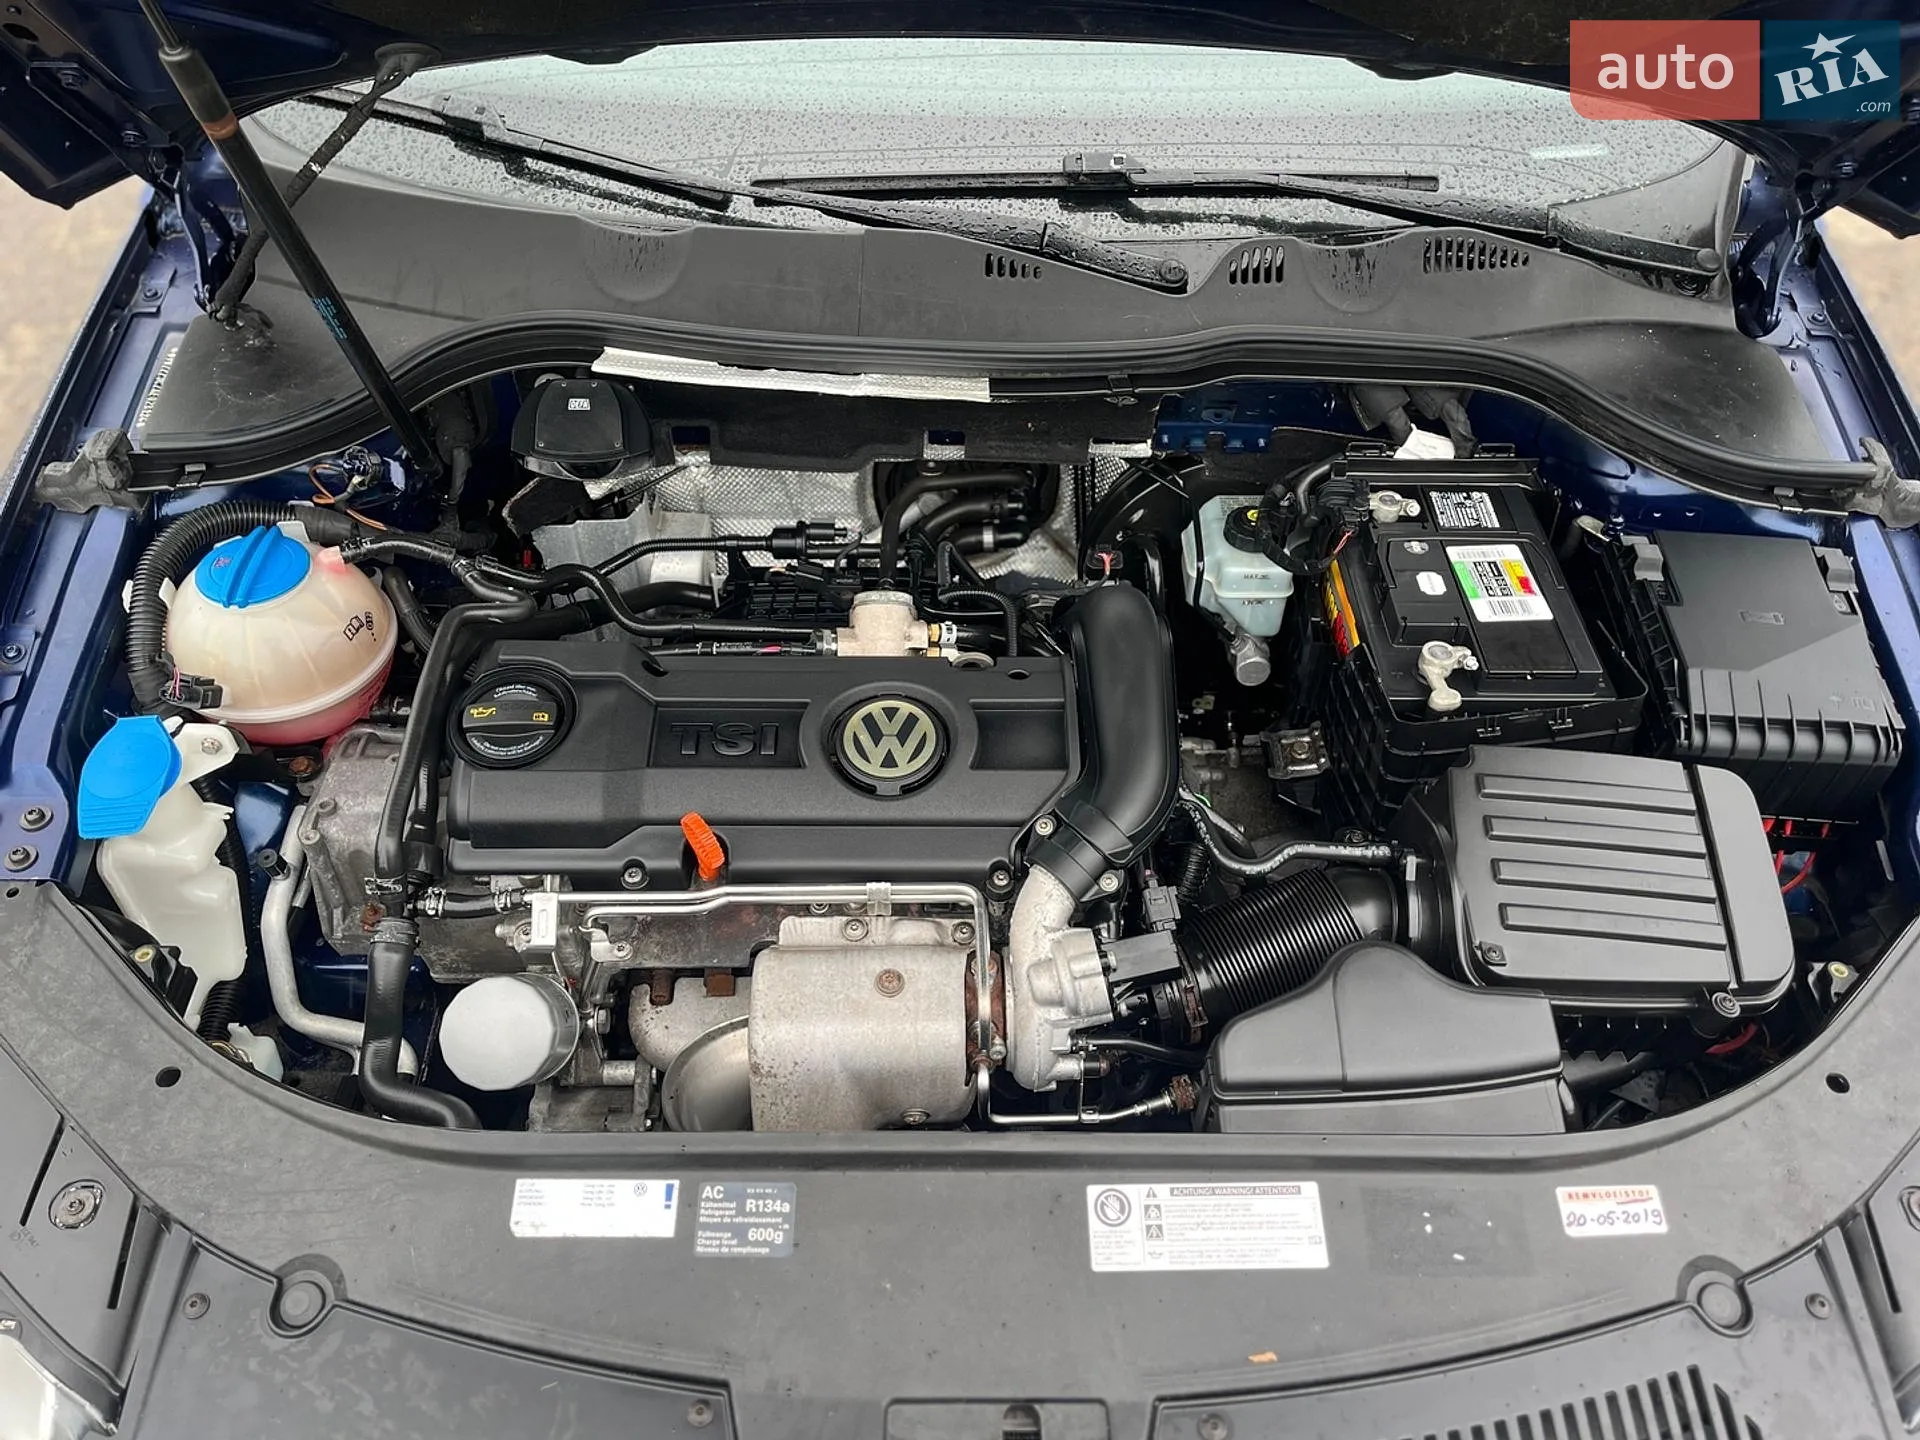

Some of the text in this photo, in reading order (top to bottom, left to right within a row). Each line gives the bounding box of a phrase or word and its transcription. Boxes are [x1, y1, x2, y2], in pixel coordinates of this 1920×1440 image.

[670, 722, 779, 755] TSI
[702, 1185, 724, 1199] AC
[746, 1199, 790, 1213] R134a
[748, 1227, 784, 1244] 600g
